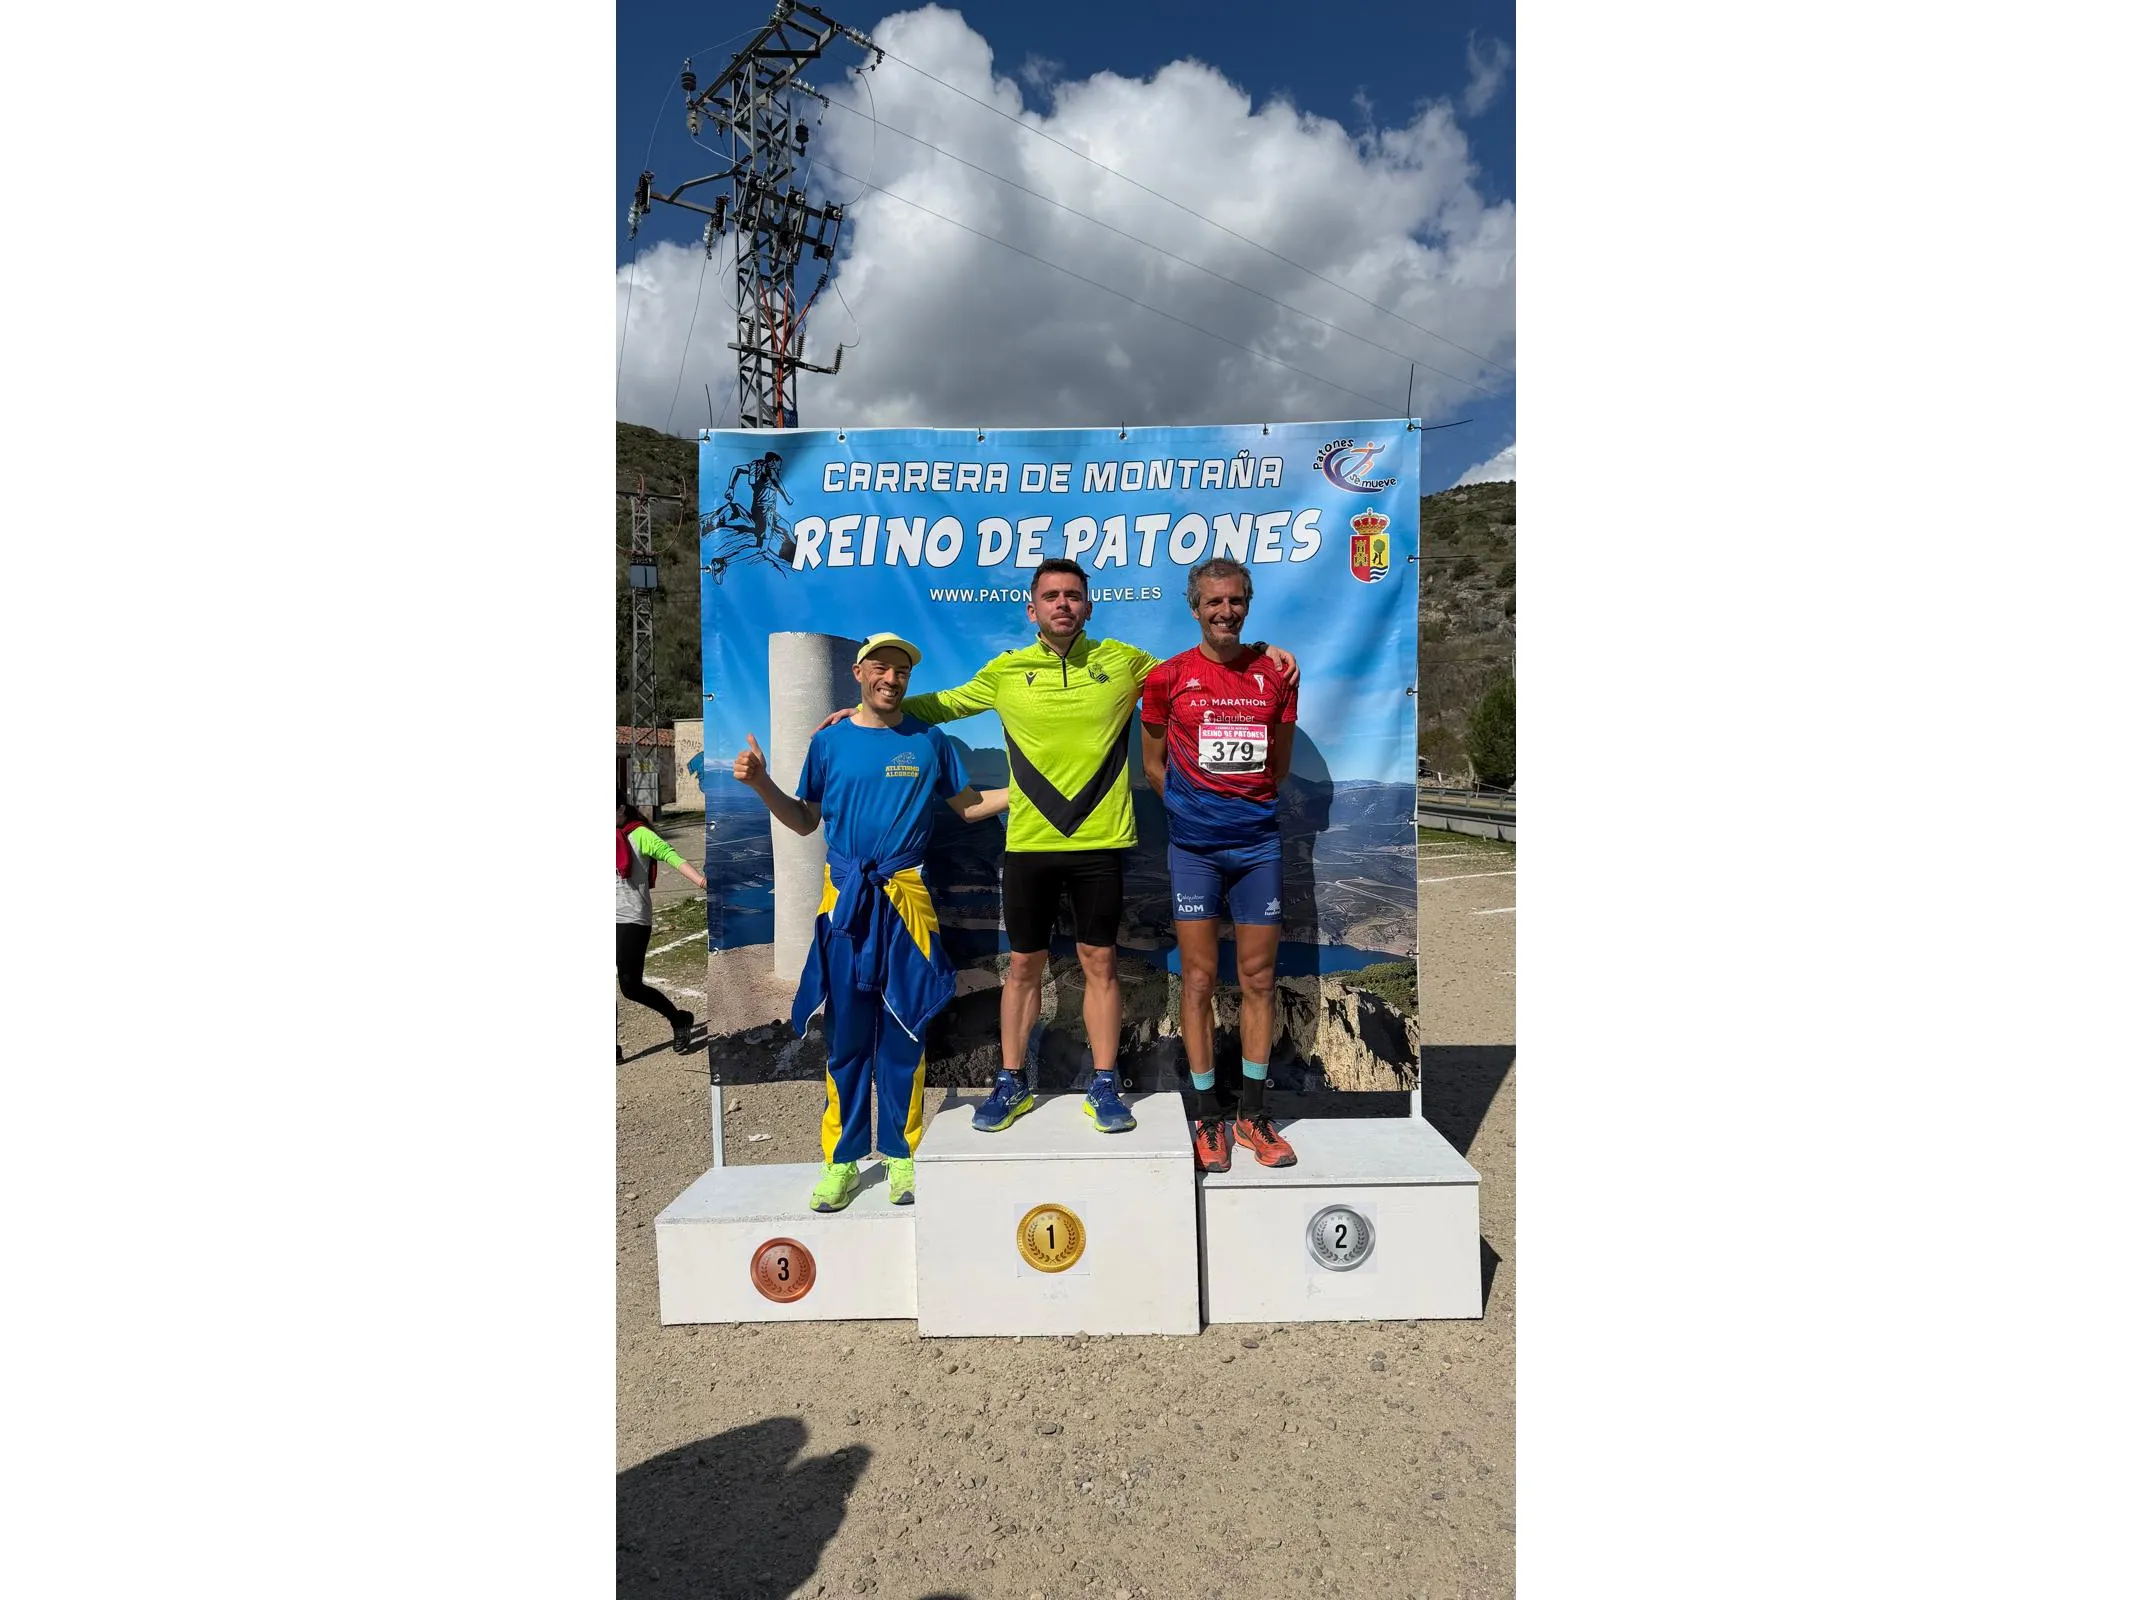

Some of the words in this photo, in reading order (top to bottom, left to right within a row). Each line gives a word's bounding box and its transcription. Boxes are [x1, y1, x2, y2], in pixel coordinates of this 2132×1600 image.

[1312, 439, 1355, 470] Patones
[822, 461, 1009, 493] CARRERA
[1019, 463, 1072, 493] DE
[1082, 449, 1284, 493] MONTAÑA
[1362, 478, 1396, 488] mueve
[791, 514, 964, 571] REINO
[976, 516, 1053, 568] DE
[1063, 508, 1323, 570] PATONES
[1212, 698, 1266, 706] MARATHON
[1202, 729, 1222, 737] REINO
[1233, 730, 1265, 738] PATONES
[1212, 741, 1254, 761] 379
[1178, 904, 1205, 913] ADM
[1046, 1224, 1055, 1249] 1
[1335, 1224, 1347, 1248] 2
[777, 1257, 790, 1281] 3
